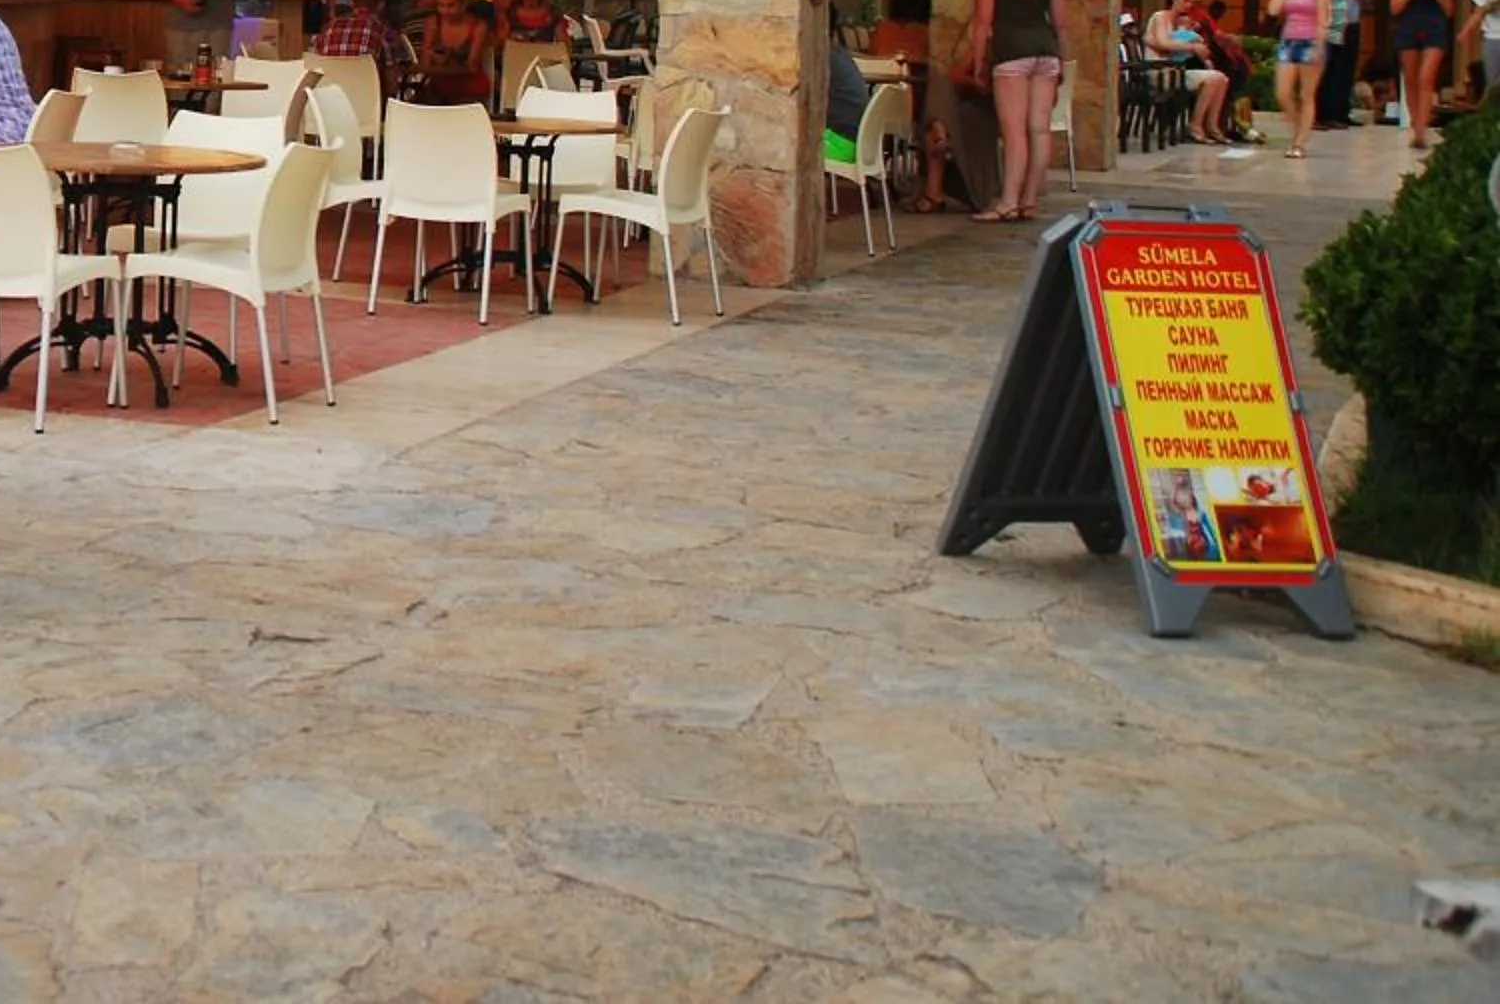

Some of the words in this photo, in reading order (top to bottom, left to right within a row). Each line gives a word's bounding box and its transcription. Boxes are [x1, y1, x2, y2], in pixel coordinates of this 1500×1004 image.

[1137, 243, 1218, 266] SÜMELA
[1107, 267, 1188, 287] GARDEN
[1191, 270, 1258, 289] HOTEL
[1124, 296, 1204, 322] ТУРЕЦКАЯ
[1206, 298, 1249, 321] БАНЯ
[1167, 325, 1220, 346] САУНА
[1166, 352, 1229, 374] ПИЛИНГ
[1135, 376, 1203, 402] ПЕННЫЙ
[1206, 381, 1275, 404] МАССАЖ
[1184, 409, 1239, 431] МАСКА
[1143, 437, 1214, 459] ГОРЯЧИЕ
[1216, 438, 1291, 460] НАПИТКИ
